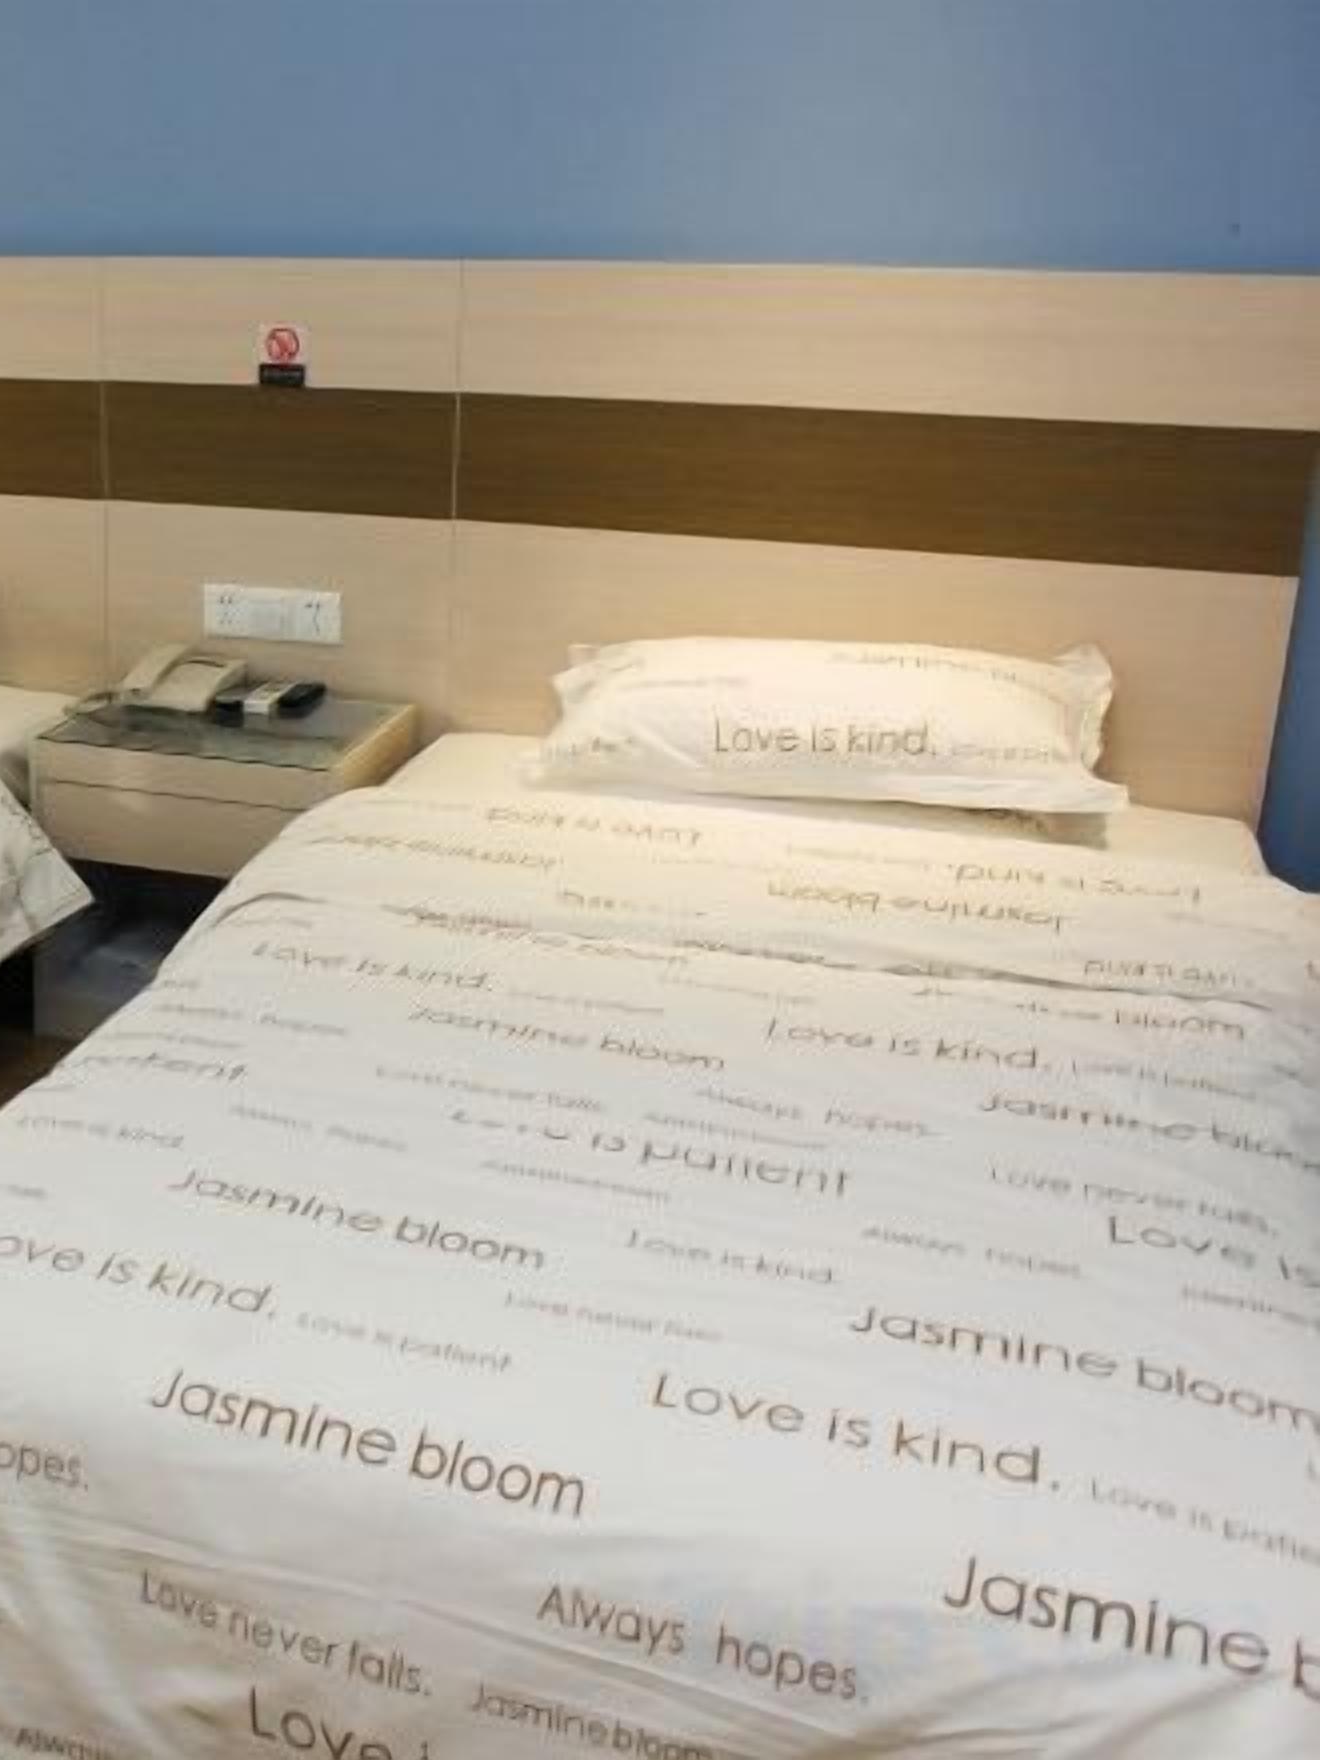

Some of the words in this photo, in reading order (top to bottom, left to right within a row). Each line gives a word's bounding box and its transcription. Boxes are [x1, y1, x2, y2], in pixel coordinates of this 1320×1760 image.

[713, 706, 801, 755] Love
[166, 1168, 384, 1234] Jasmine
[394, 1209, 547, 1273] bloom
[145, 1259, 277, 1321] kind.
[849, 1304, 1118, 1380] Jasmine
[1136, 1356, 1320, 1436] bloom
[152, 1366, 397, 1466] Jasmine
[408, 1423, 585, 1520] bloom
[652, 1373, 804, 1434] Love
[827, 1407, 872, 1451] is
[892, 1418, 1061, 1493] kind.
[140, 1569, 219, 1630] Love
[228, 1608, 340, 1668] never
[536, 1583, 688, 1659] Always
[713, 1624, 871, 1706] hopes.
[942, 1555, 1272, 1678] Jasmine
